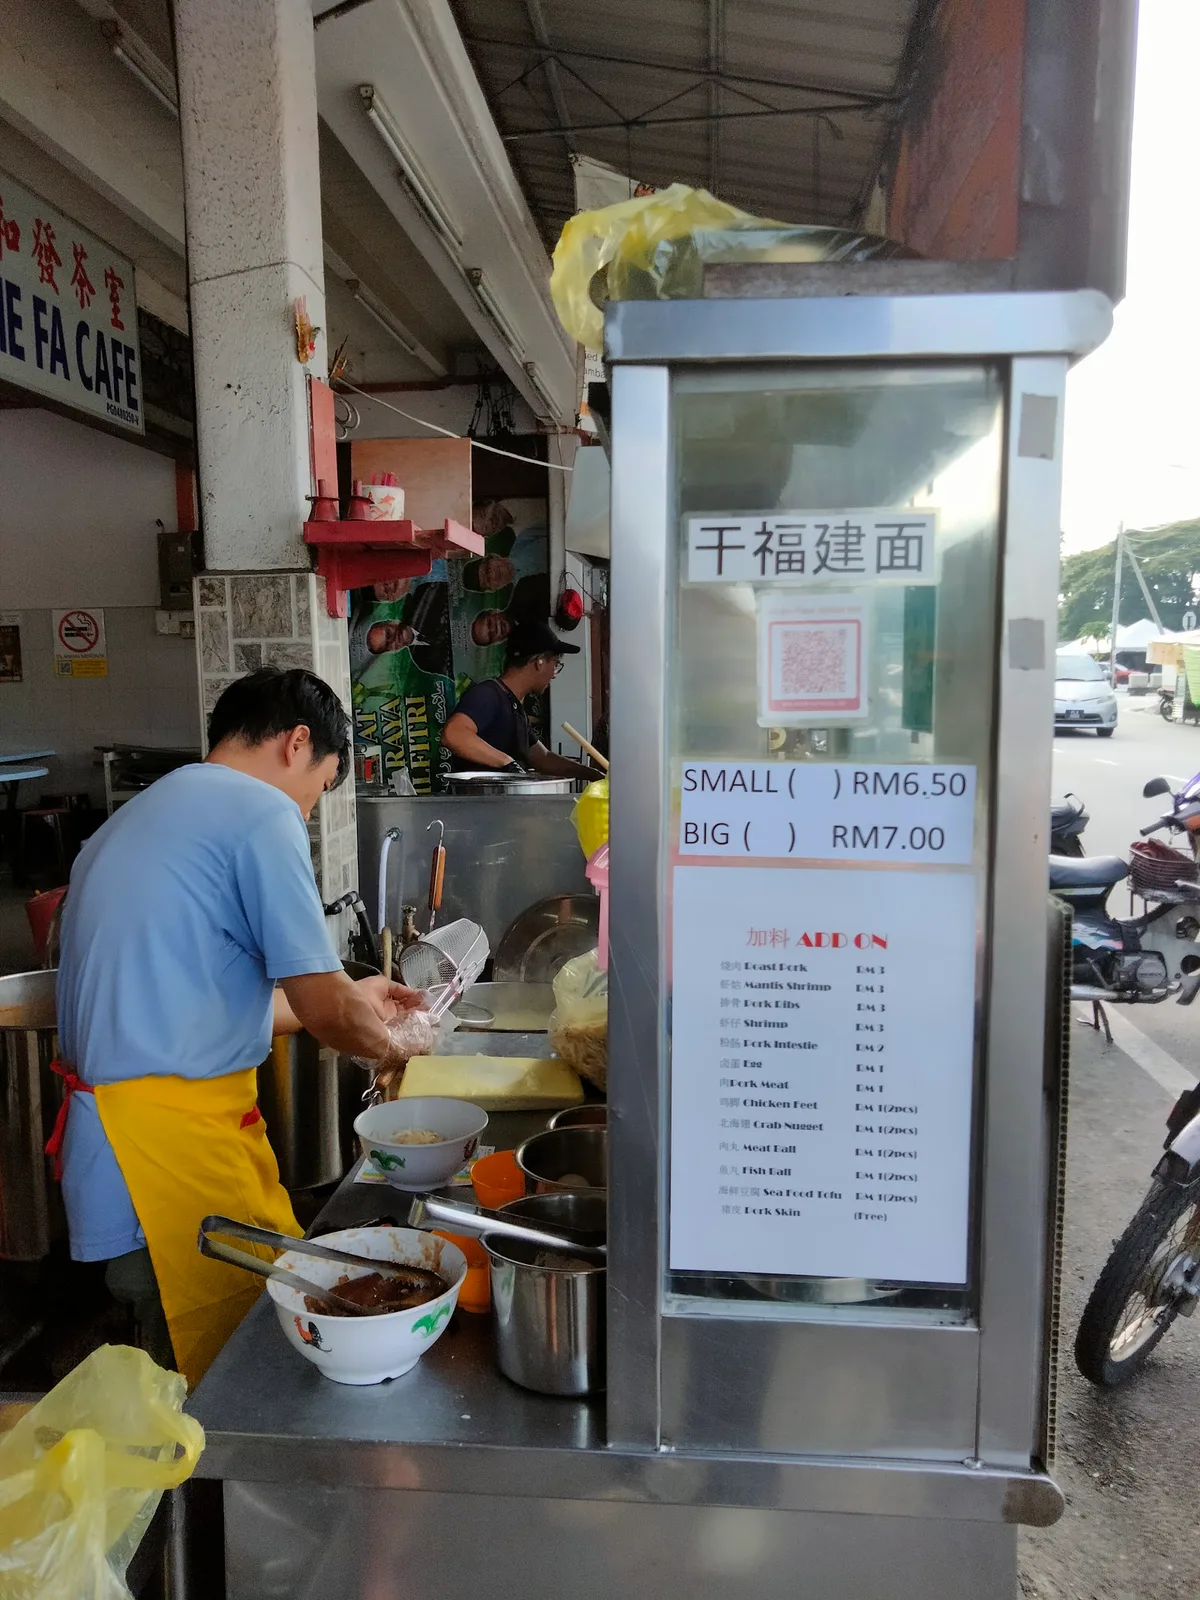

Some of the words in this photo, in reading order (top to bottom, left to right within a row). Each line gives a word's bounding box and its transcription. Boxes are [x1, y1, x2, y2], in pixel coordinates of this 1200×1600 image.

[0, 277, 25, 361] E
[32, 295, 70, 381] FA
[76, 320, 138, 412] CAFE
[695, 520, 926, 576] 干福建面
[379, 696, 407, 769] RAYA
[405, 695, 432, 795] ILFITRI
[684, 769, 778, 792] SMALL
[853, 771, 966, 799] RM6.50
[684, 822, 729, 845] BIG
[833, 825, 944, 850] RM7.00
[746, 927, 790, 948] 加料
[796, 932, 848, 948] ADD
[853, 933, 888, 950] ON
[744, 962, 776, 972] Roast
[780, 963, 807, 973] Pork
[856, 965, 874, 974] RM
[877, 966, 885, 975] 3
[744, 981, 784, 990] Mantis
[786, 982, 831, 992] Shrimp
[856, 984, 874, 993] RM
[877, 985, 884, 993] 3
[744, 999, 772, 1009] Pork
[857, 1003, 875, 1012] RM
[878, 1004, 885, 1012] 3
[744, 1019, 788, 1029] Shrimp
[856, 1023, 874, 1032] RM
[877, 1024, 884, 1032] 3
[744, 1040, 772, 1049] Pork
[856, 1043, 874, 1052] RM
[877, 1044, 885, 1052] 2
[743, 1060, 763, 1069] Egg
[856, 1064, 874, 1073] RM
[760, 1080, 789, 1090] Meat
[856, 1084, 874, 1092] RM
[743, 1099, 790, 1109] Chicken
[855, 1103, 874, 1113] RM
[855, 1125, 874, 1134] RM
[743, 1143, 771, 1153] Meat
[855, 1149, 874, 1158] RM
[855, 1171, 874, 1181] RM
[763, 1188, 783, 1197] Sea
[855, 1193, 874, 1201] RM
[744, 1207, 773, 1216] Pork
[775, 1208, 800, 1217] Skin
